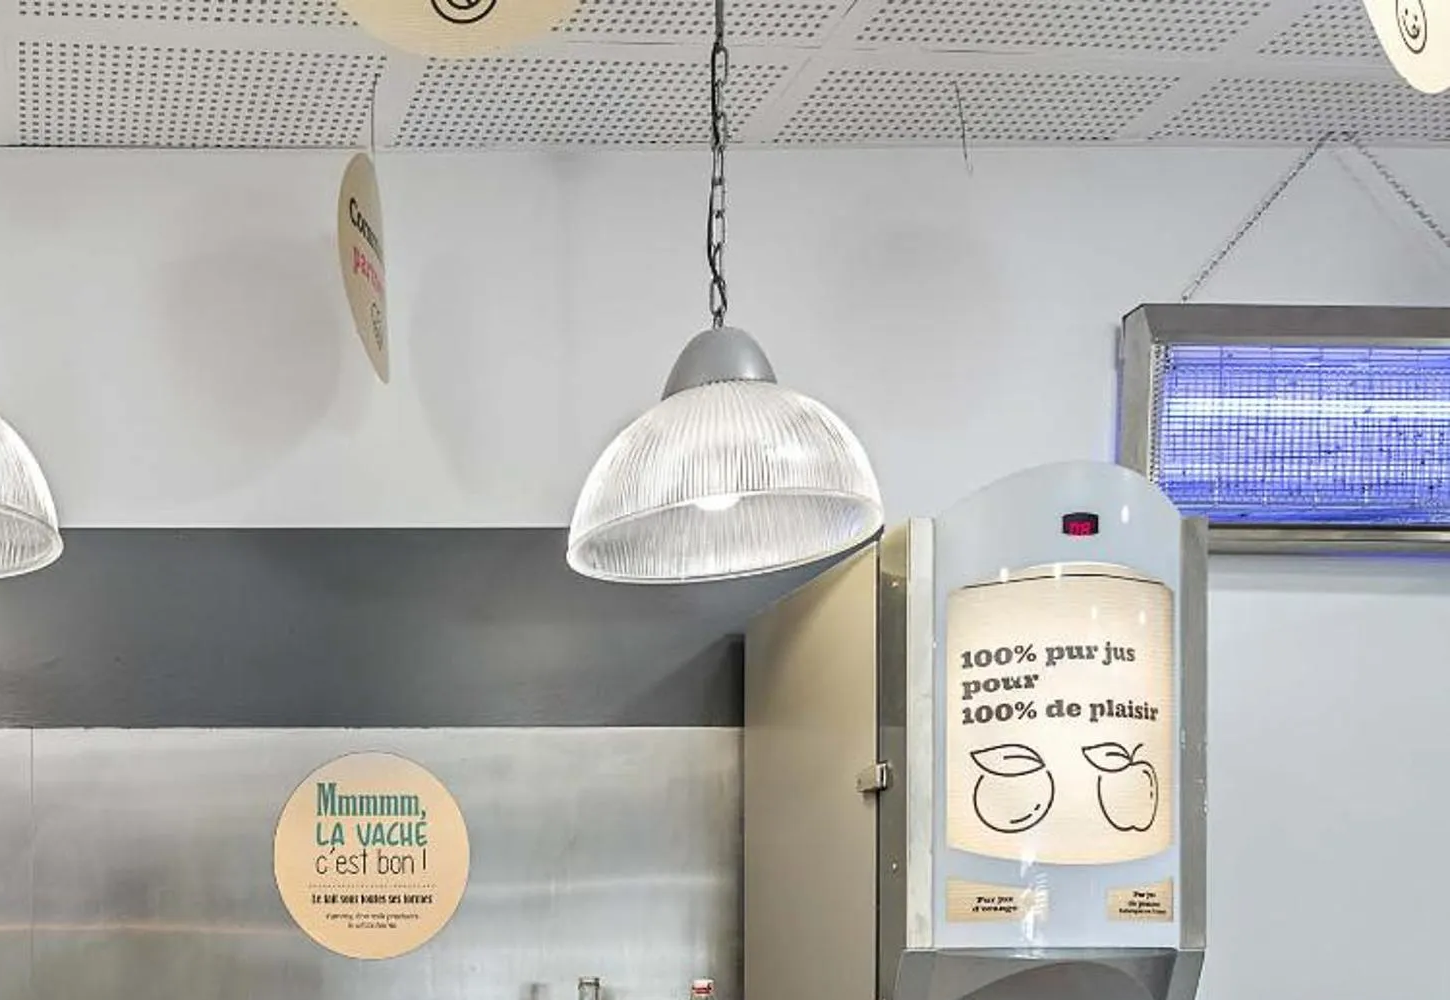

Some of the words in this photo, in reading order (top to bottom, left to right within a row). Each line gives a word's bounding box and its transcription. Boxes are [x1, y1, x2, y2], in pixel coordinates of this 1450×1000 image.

[961, 643, 1038, 669] 100%
[1045, 645, 1099, 667] pur
[1102, 641, 1136, 666] jus
[961, 674, 1040, 700] pour
[962, 700, 1038, 725] 100%
[1045, 699, 1082, 718] de
[1089, 699, 1160, 723] plaisir
[316, 822, 345, 847] LA
[356, 821, 429, 847] VACHE
[316, 846, 369, 875] c'est
[377, 848, 415, 875] bon
